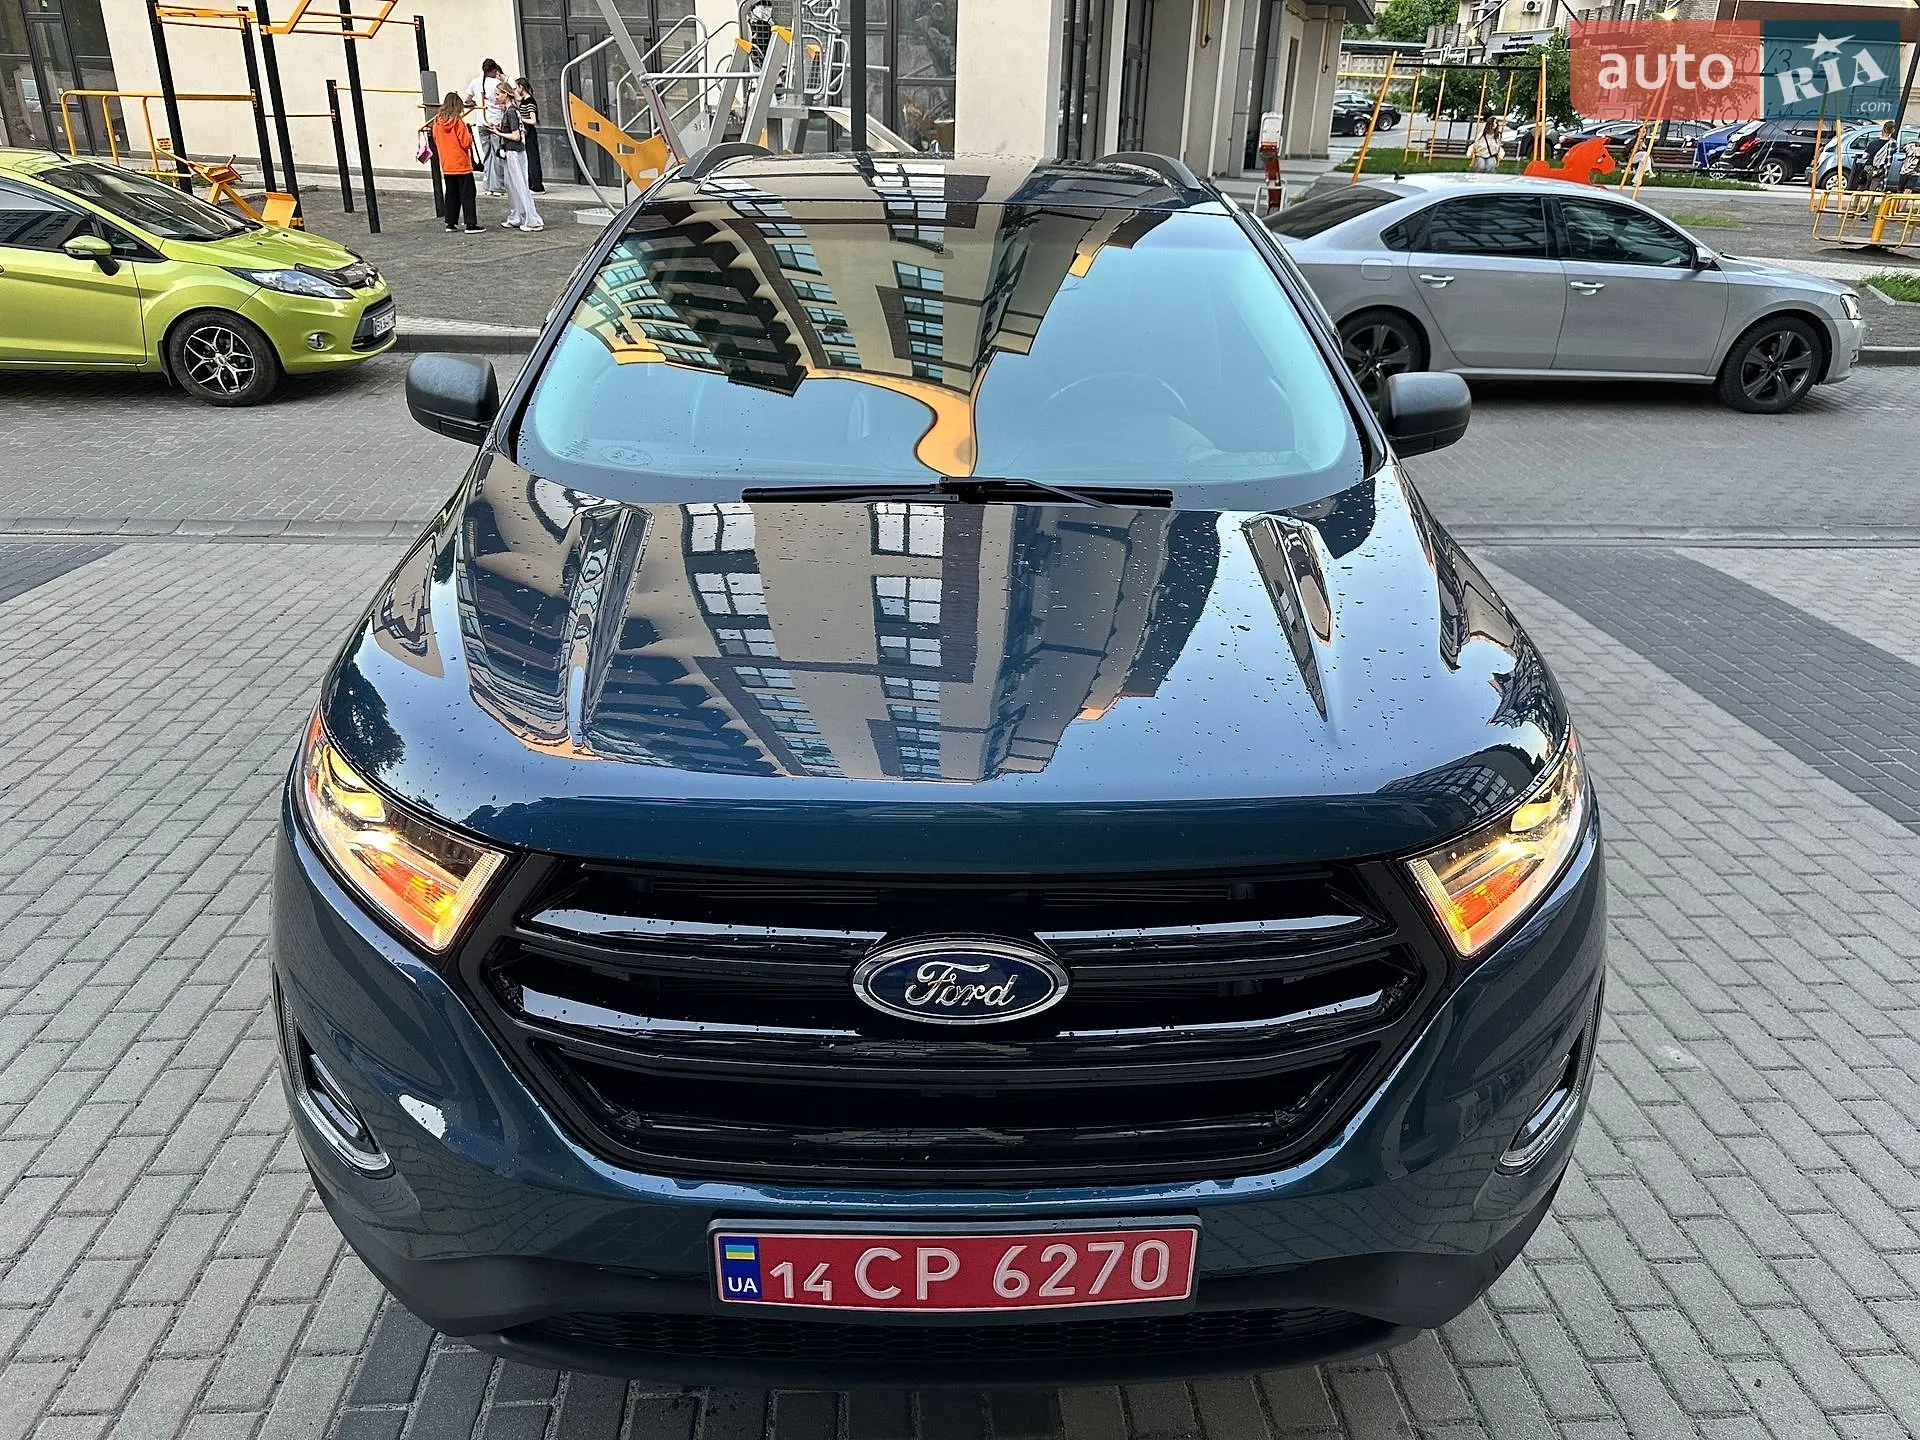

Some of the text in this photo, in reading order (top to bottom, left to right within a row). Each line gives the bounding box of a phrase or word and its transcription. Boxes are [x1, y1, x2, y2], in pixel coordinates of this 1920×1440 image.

[904, 960, 1019, 1007] Ford
[727, 1276, 758, 1294] UA
[769, 1239, 1171, 1301] 14 CP 6270
